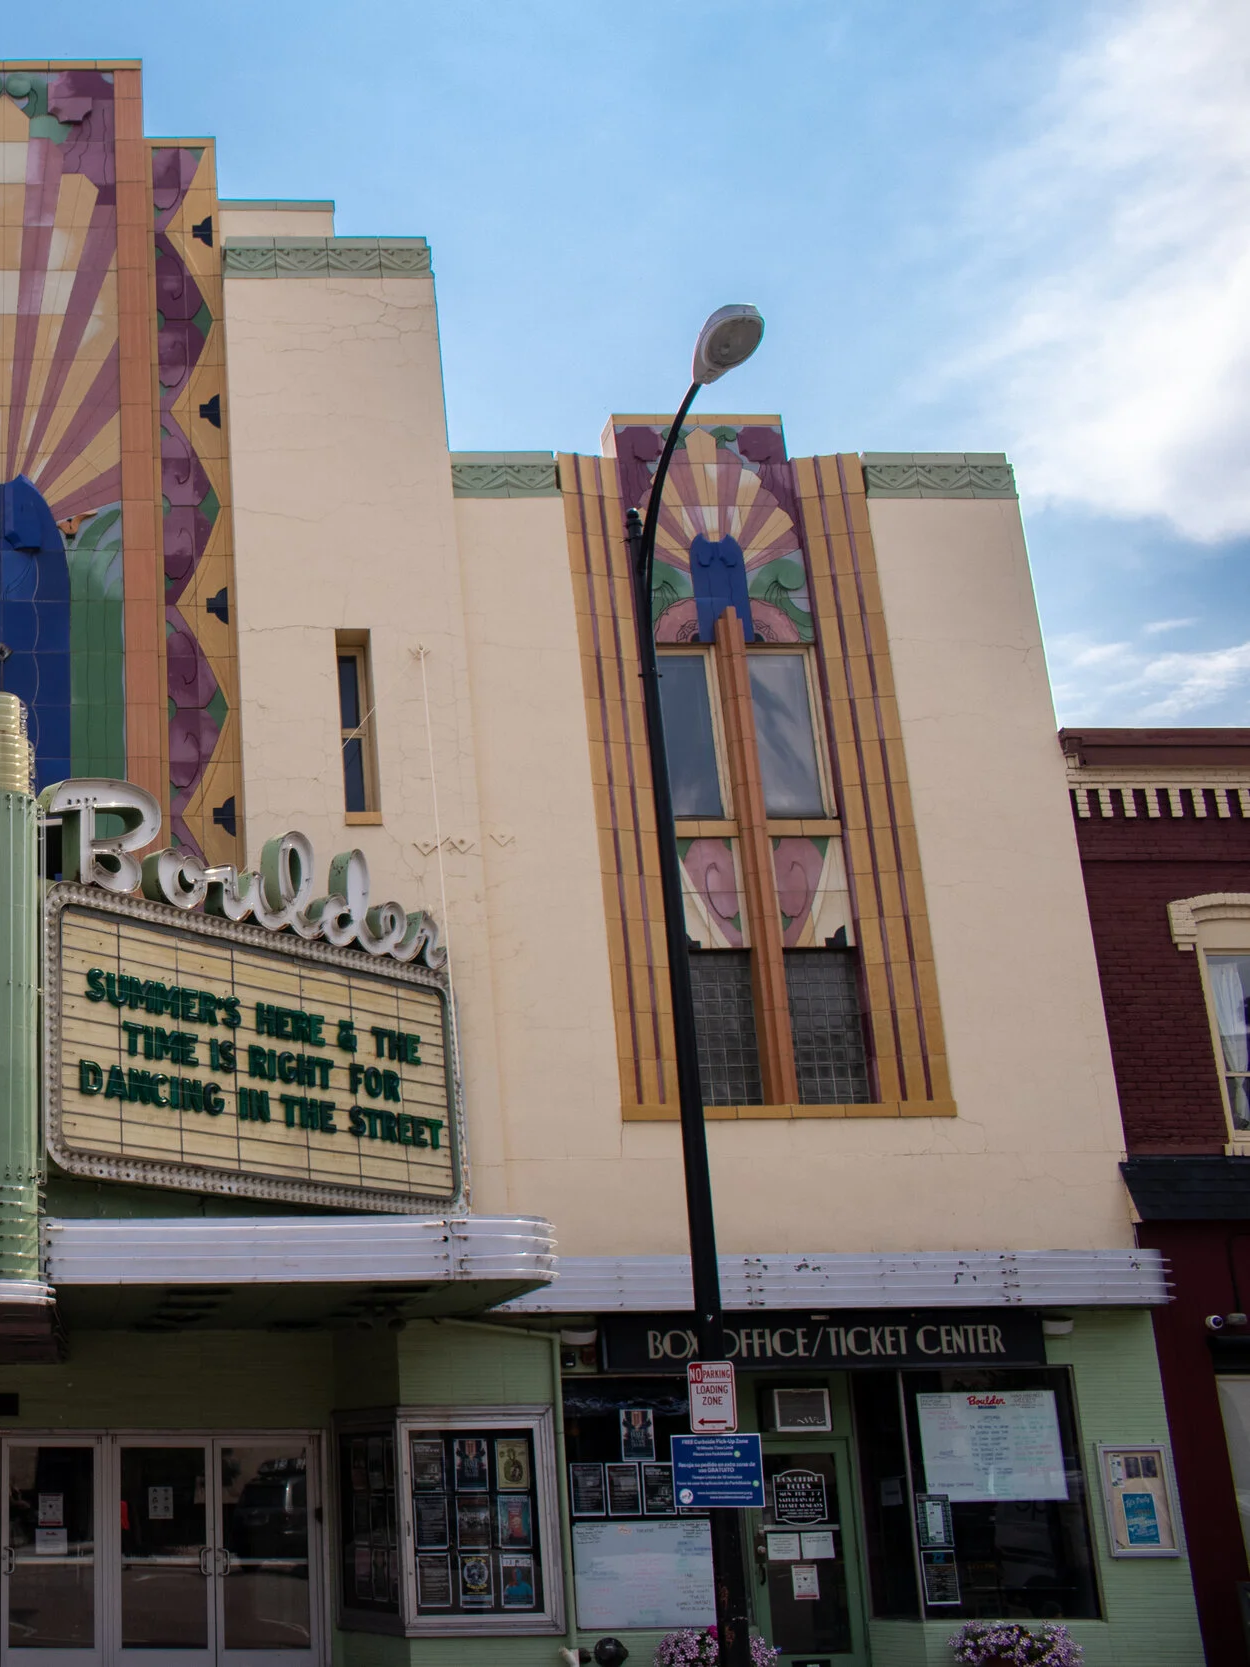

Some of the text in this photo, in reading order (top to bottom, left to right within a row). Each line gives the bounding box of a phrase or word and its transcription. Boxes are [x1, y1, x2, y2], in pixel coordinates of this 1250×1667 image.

[37, 777, 448, 970] Boulder
[85, 967, 421, 1065] SUMMER'S HERE & THE
[122, 1020, 401, 1102] TIME IS RIGHT FOR
[79, 1058, 444, 1150] DANCING IN THE STREET
[647, 1329, 699, 1360] BOX
[916, 1324, 1006, 1355] CENTER
[690, 1367, 731, 1382] NO PARKING
[696, 1385, 729, 1395] LOADING
[702, 1396, 724, 1406] ZONE
[967, 1395, 1006, 1406] Boulder
